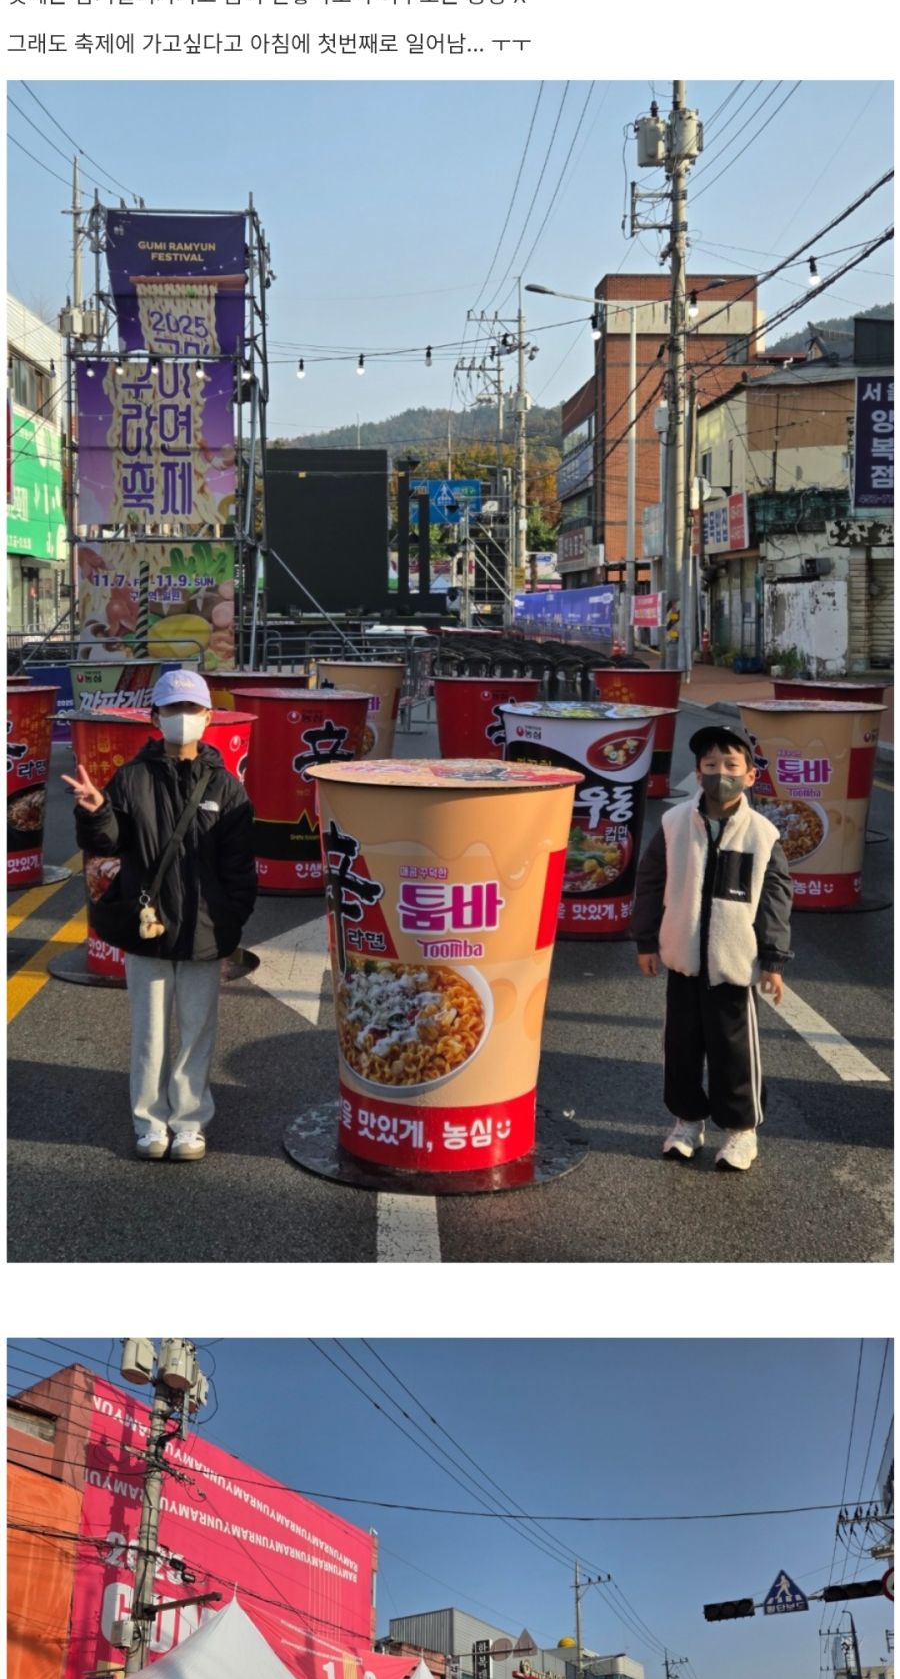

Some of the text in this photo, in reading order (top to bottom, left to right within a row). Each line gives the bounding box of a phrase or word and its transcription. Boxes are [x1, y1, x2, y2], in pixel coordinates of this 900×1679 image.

[138, 241, 216, 251] GUMI RAMYUN
[151, 253, 204, 262] FESTIVAL
[150, 311, 209, 339] 2025
[122, 404, 192, 457] 라면
[122, 462, 192, 515] 축제
[130, 591, 158, 602] 구역
[18, 759, 48, 780] 라면
[776, 757, 832, 785] 툼바
[574, 785, 634, 829] 우동
[397, 880, 505, 934] 툼바
[572, 903, 618, 921] 맛있게,
[347, 929, 386, 951] 라면
[417, 939, 484, 960] Toomba
[358, 1109, 492, 1152] 맛있게, 농심
